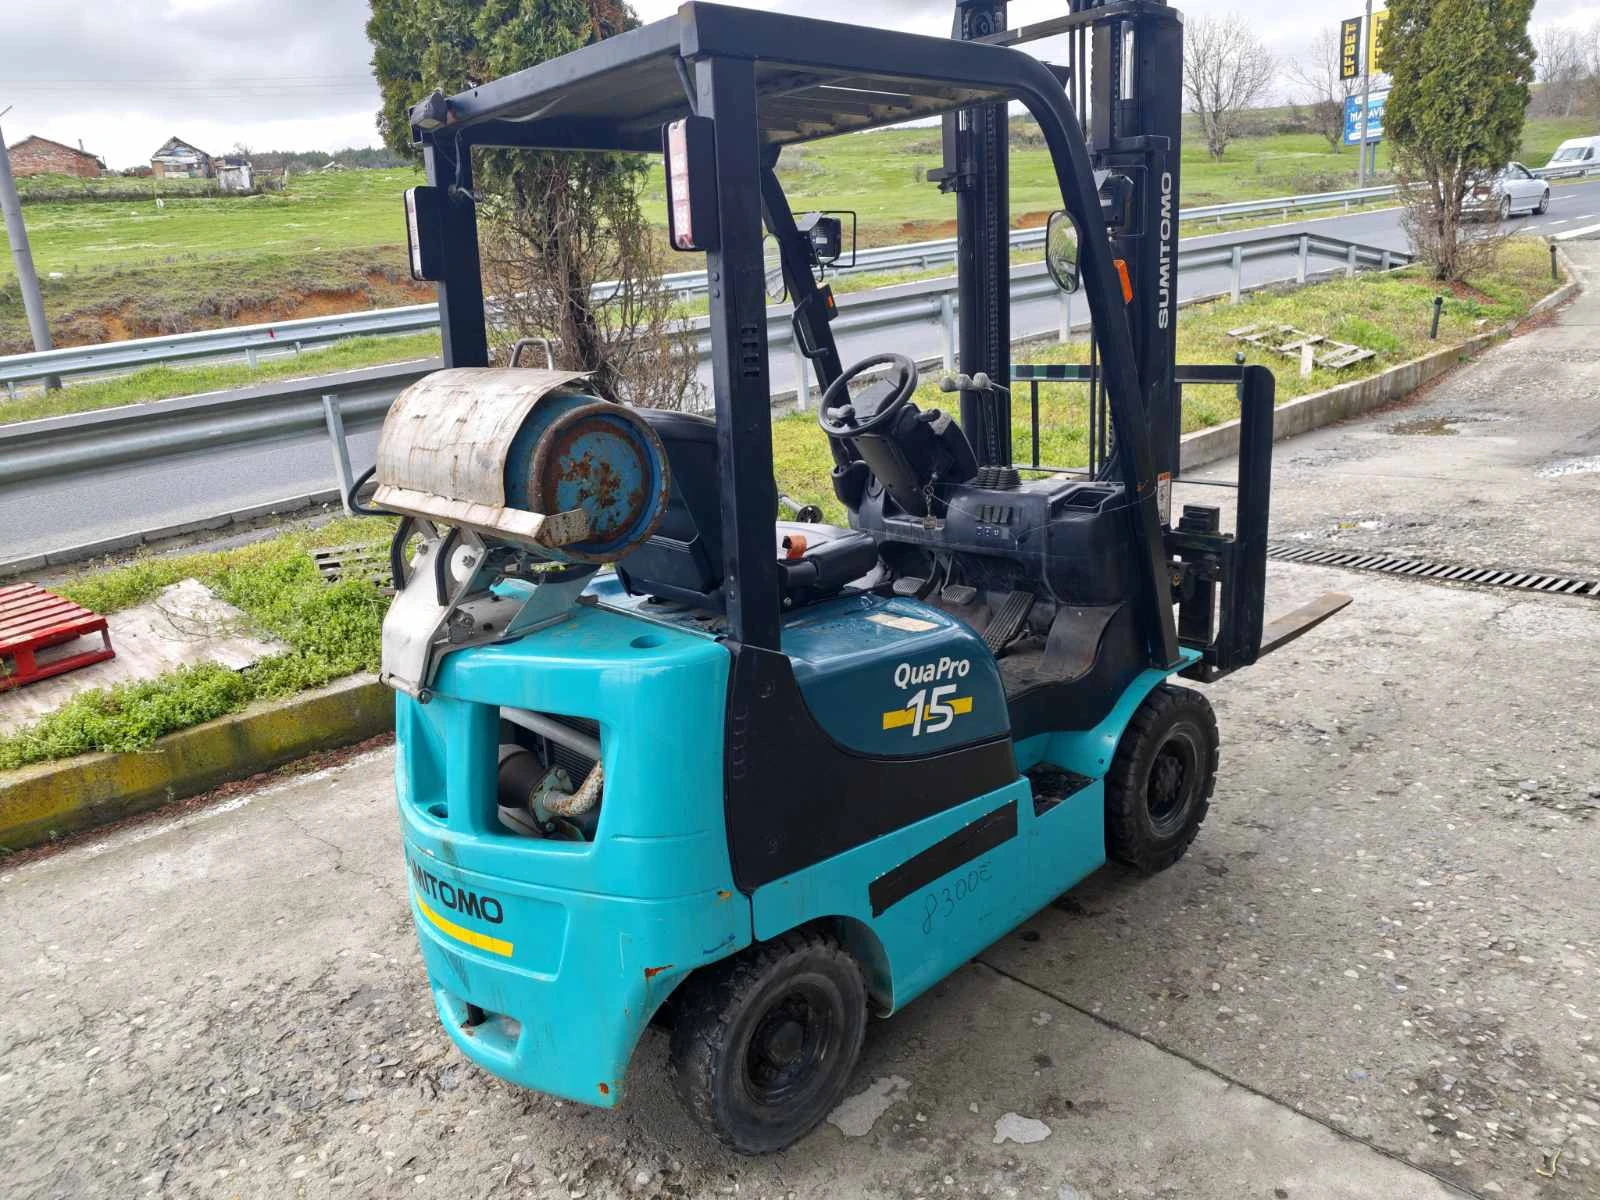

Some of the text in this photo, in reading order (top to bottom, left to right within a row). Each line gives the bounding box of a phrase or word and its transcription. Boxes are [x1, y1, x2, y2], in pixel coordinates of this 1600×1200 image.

[1343, 23, 1357, 77] EFBET
[1158, 172, 1172, 329] SUMITOMO
[894, 656, 970, 690] QuaPro
[905, 683, 958, 737] 15
[410, 857, 504, 925] MITOMO
